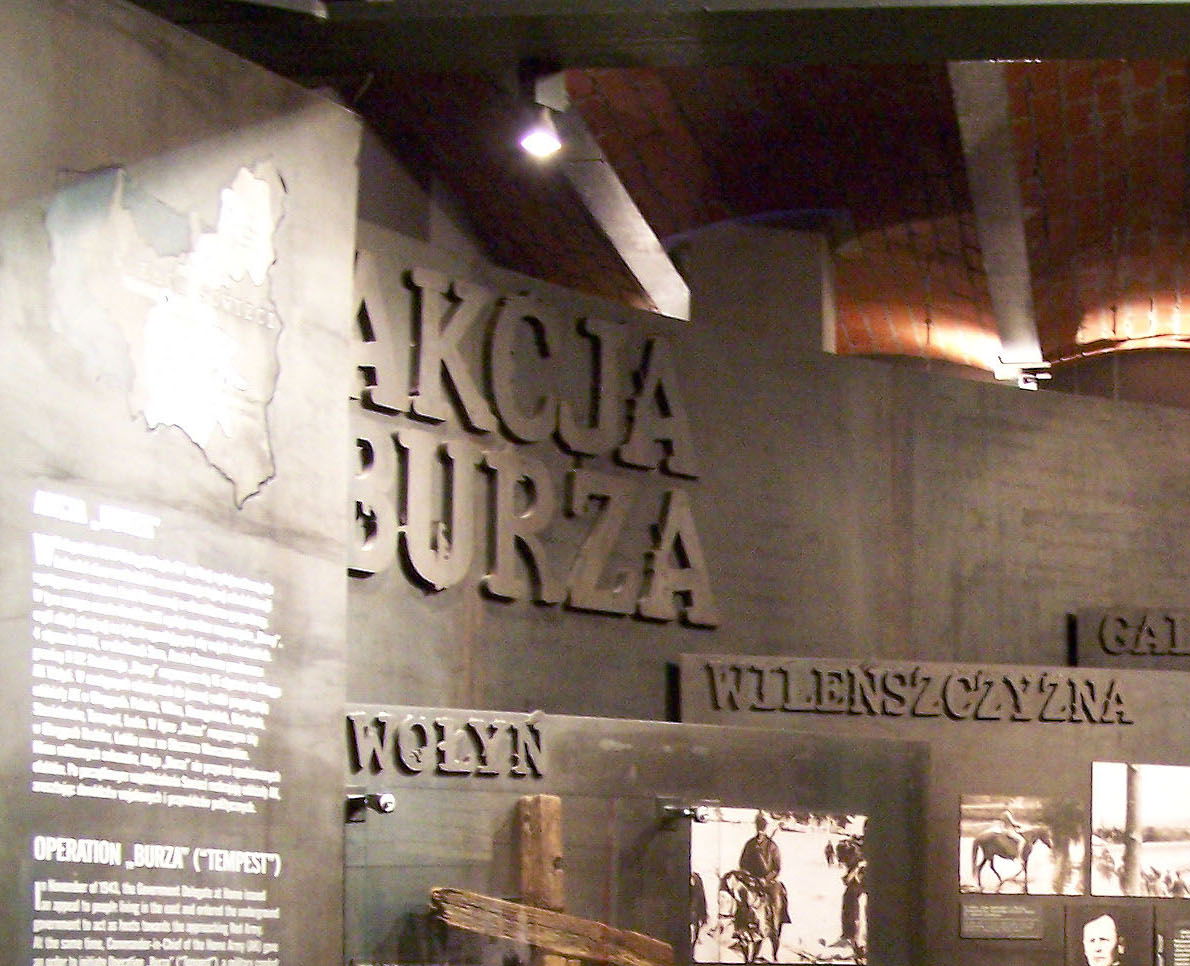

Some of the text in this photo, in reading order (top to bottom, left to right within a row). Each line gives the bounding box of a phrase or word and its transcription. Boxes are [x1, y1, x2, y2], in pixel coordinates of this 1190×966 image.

[349, 250, 698, 481] AKCJA
[346, 420, 717, 630] BURZA
[703, 661, 1135, 725] WILENSZCZYZNA
[33, 835, 122, 865] OPERATION
